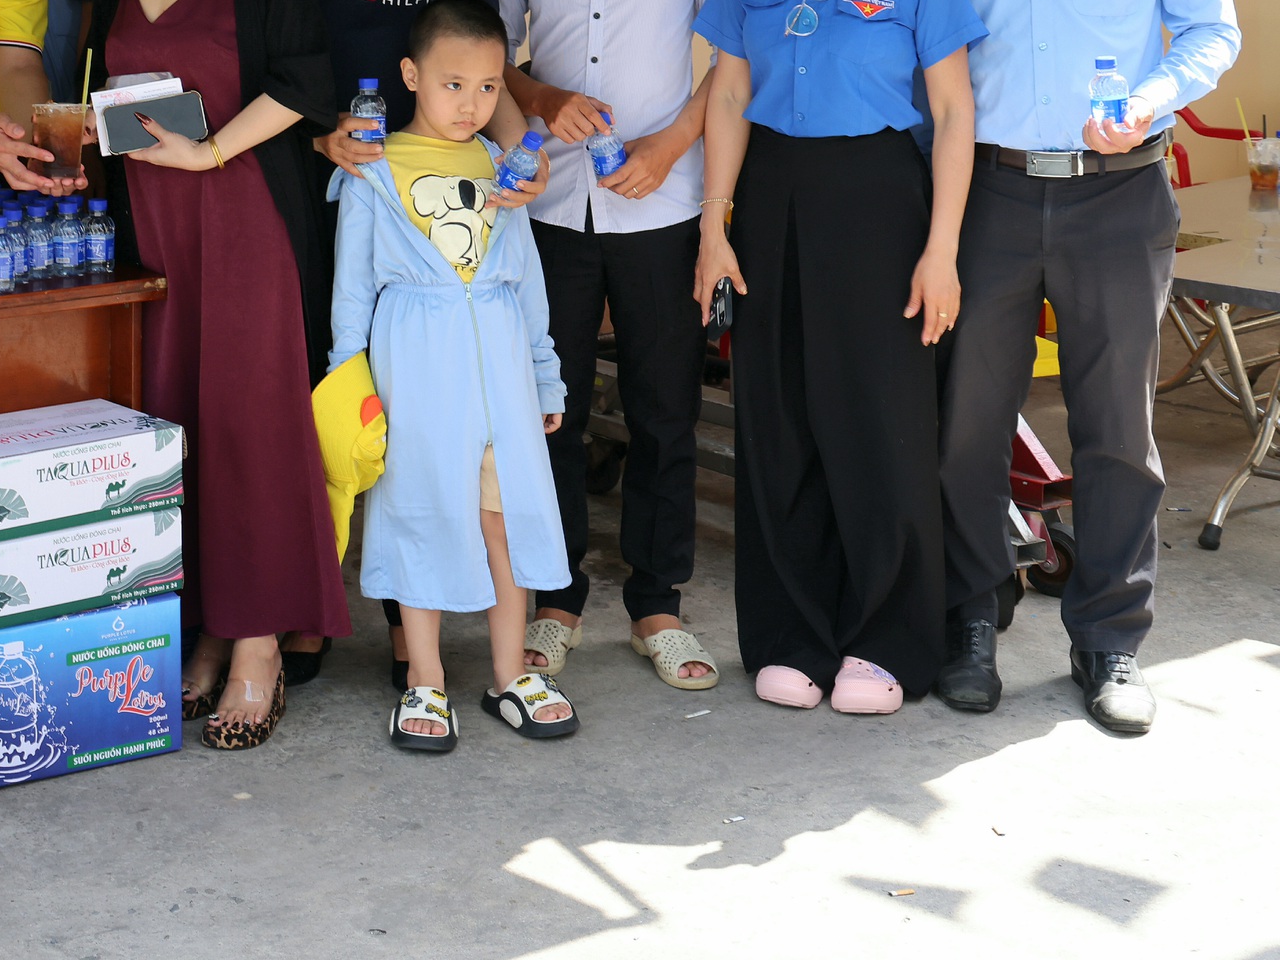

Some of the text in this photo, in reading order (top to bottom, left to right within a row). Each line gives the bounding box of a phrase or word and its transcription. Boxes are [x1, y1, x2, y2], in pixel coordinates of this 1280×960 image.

[72, 638, 165, 663] NƯỚC UỐNG ĐÓNG CHAI
[149, 714, 168, 723] 200ml
[74, 753, 92, 766] SUỐI
[123, 744, 145, 756] HẠNH
